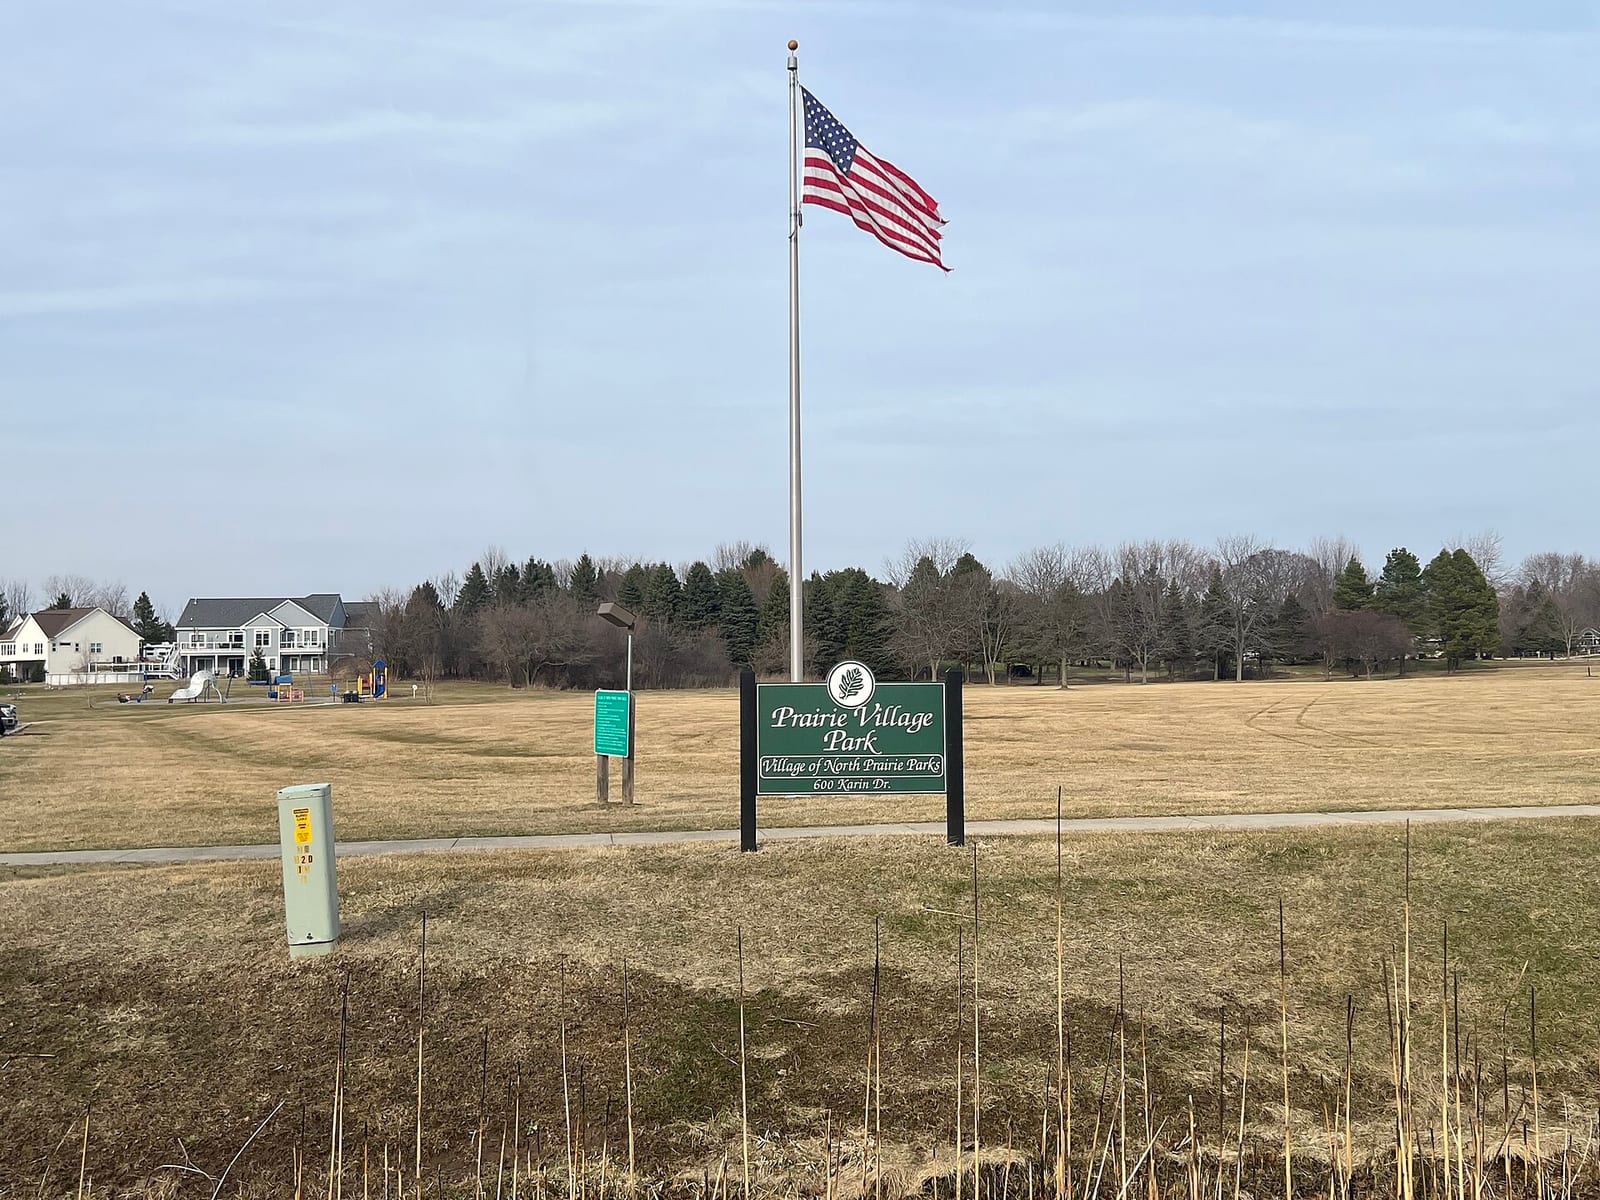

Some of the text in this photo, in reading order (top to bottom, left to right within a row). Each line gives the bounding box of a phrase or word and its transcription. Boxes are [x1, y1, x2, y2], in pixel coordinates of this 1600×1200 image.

[772, 703, 933, 733] Prairie Village
[823, 729, 882, 754] Park
[763, 757, 940, 776] Village of North Prairie Parks
[813, 778, 891, 791] 600 Karin Dr.
